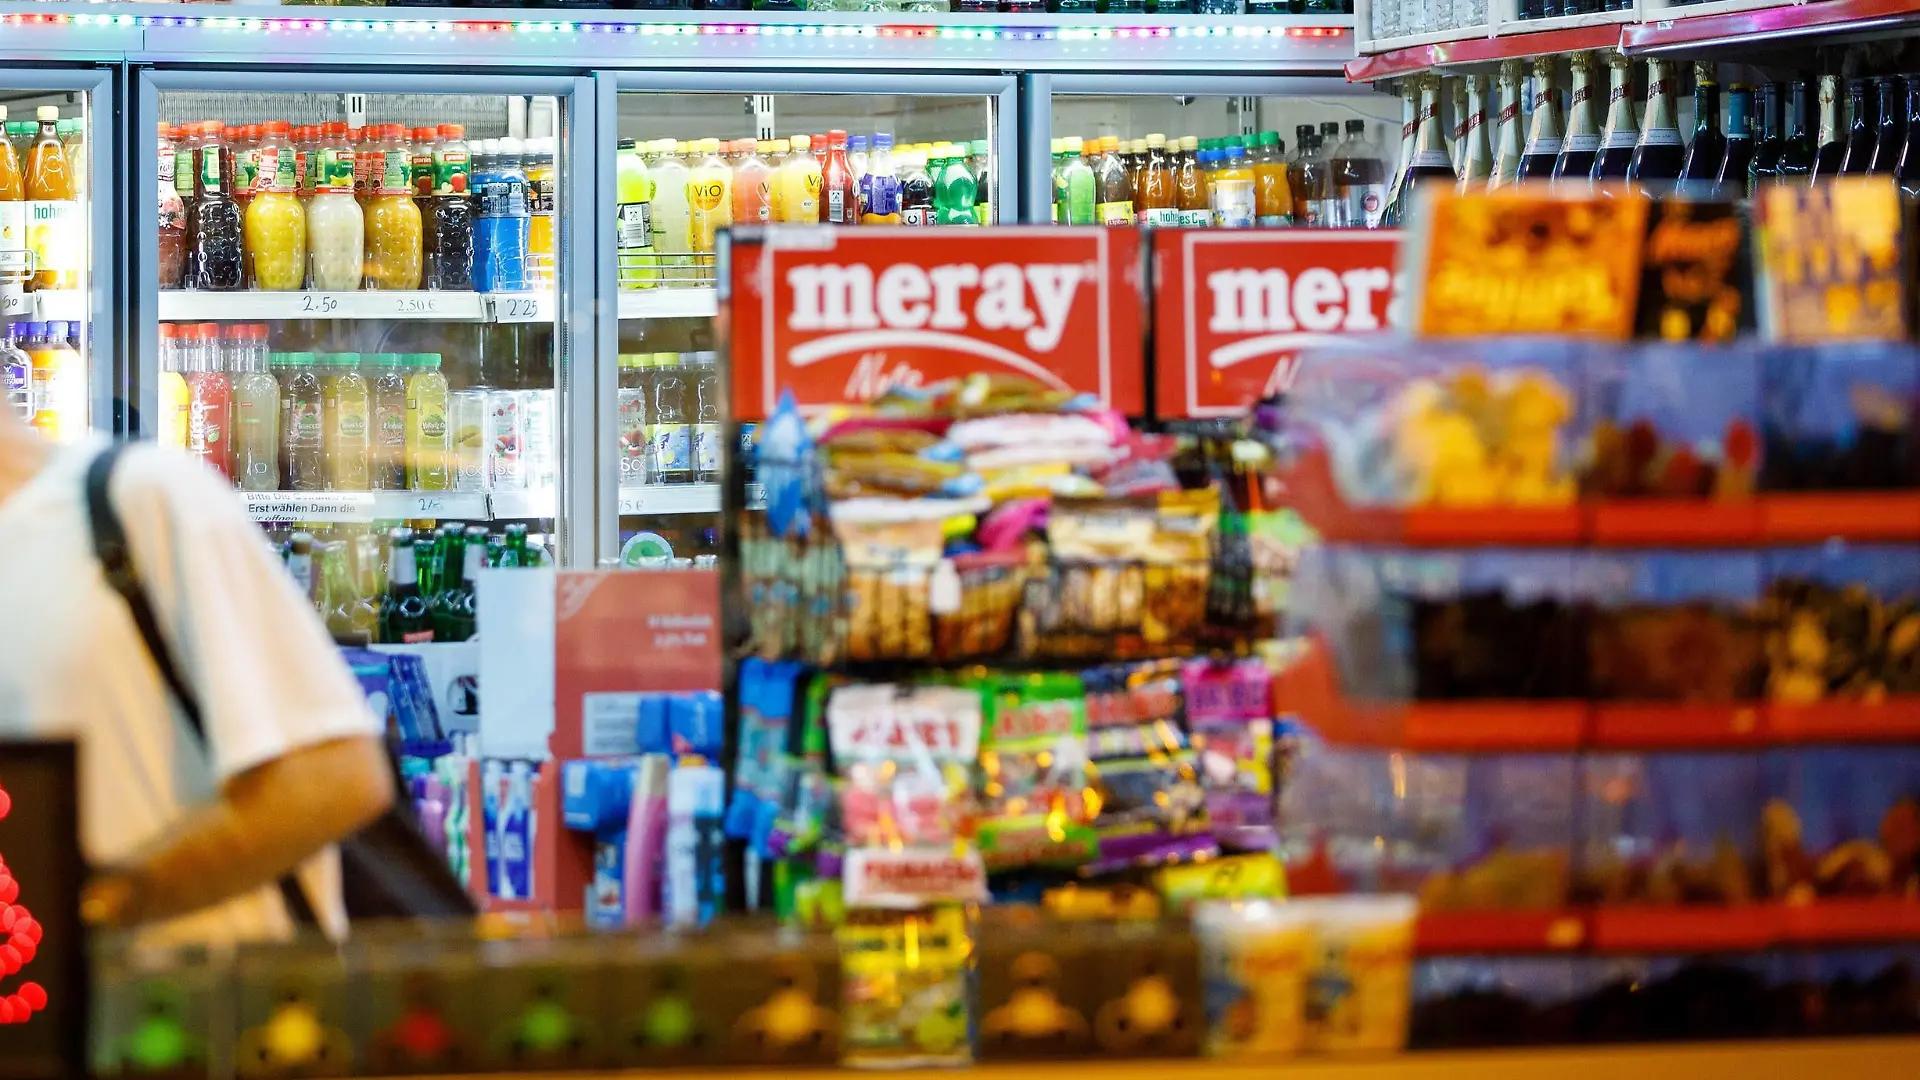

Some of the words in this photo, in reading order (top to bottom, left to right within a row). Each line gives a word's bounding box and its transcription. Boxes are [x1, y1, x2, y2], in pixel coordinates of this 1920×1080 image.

[693, 184, 722, 198] ViO
[303, 295, 338, 312] 2.50
[397, 299, 425, 312] 2.50
[786, 261, 1084, 352] meray
[248, 503, 270, 513] Erst
[271, 502, 308, 513] wählen
[310, 503, 337, 513] Dann
[340, 503, 356, 513] die
